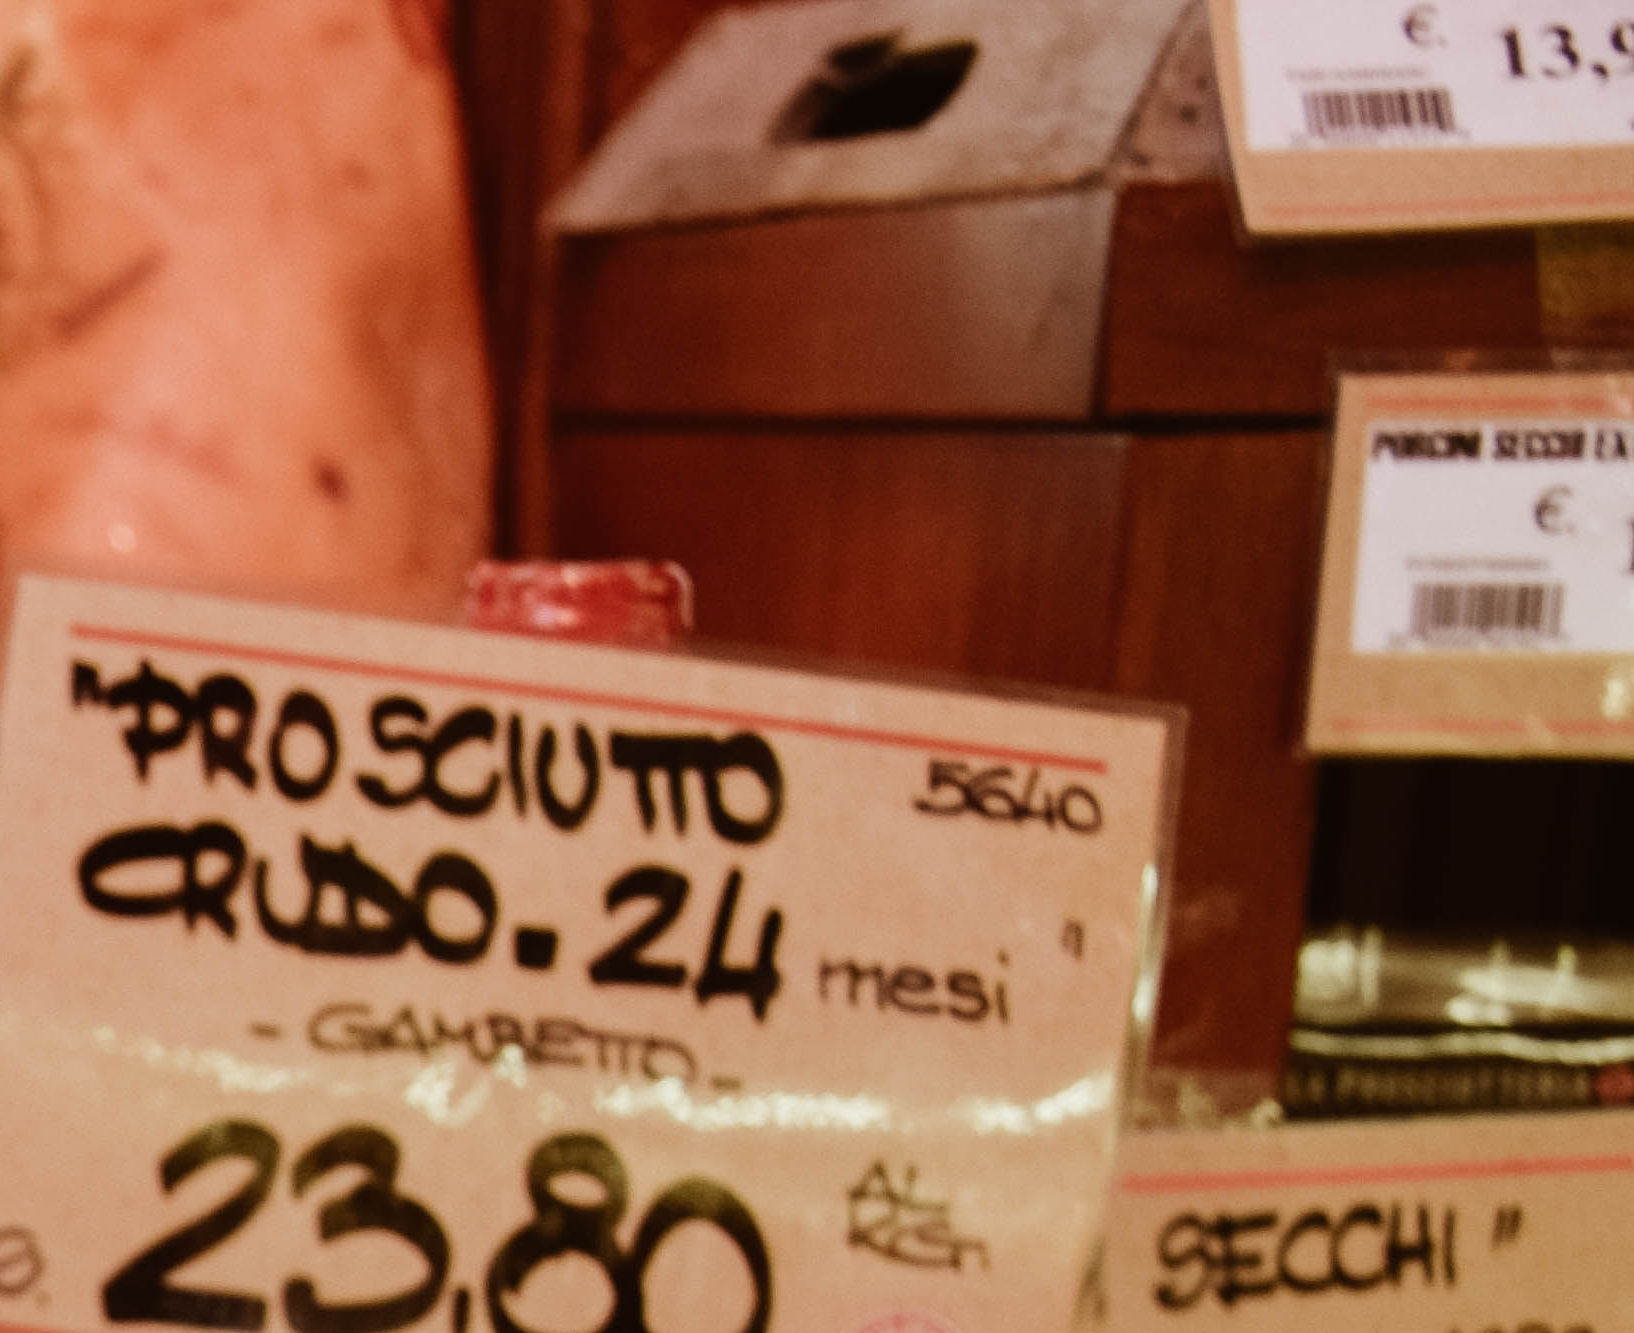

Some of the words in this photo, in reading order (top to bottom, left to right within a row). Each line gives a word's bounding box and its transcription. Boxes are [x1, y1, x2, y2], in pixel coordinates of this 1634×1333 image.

[913, 759, 1103, 836] 5640
[590, 864, 784, 1024] 24
[818, 946, 1010, 1026] mesi
[1154, 1205, 1458, 1312] SECCHI
